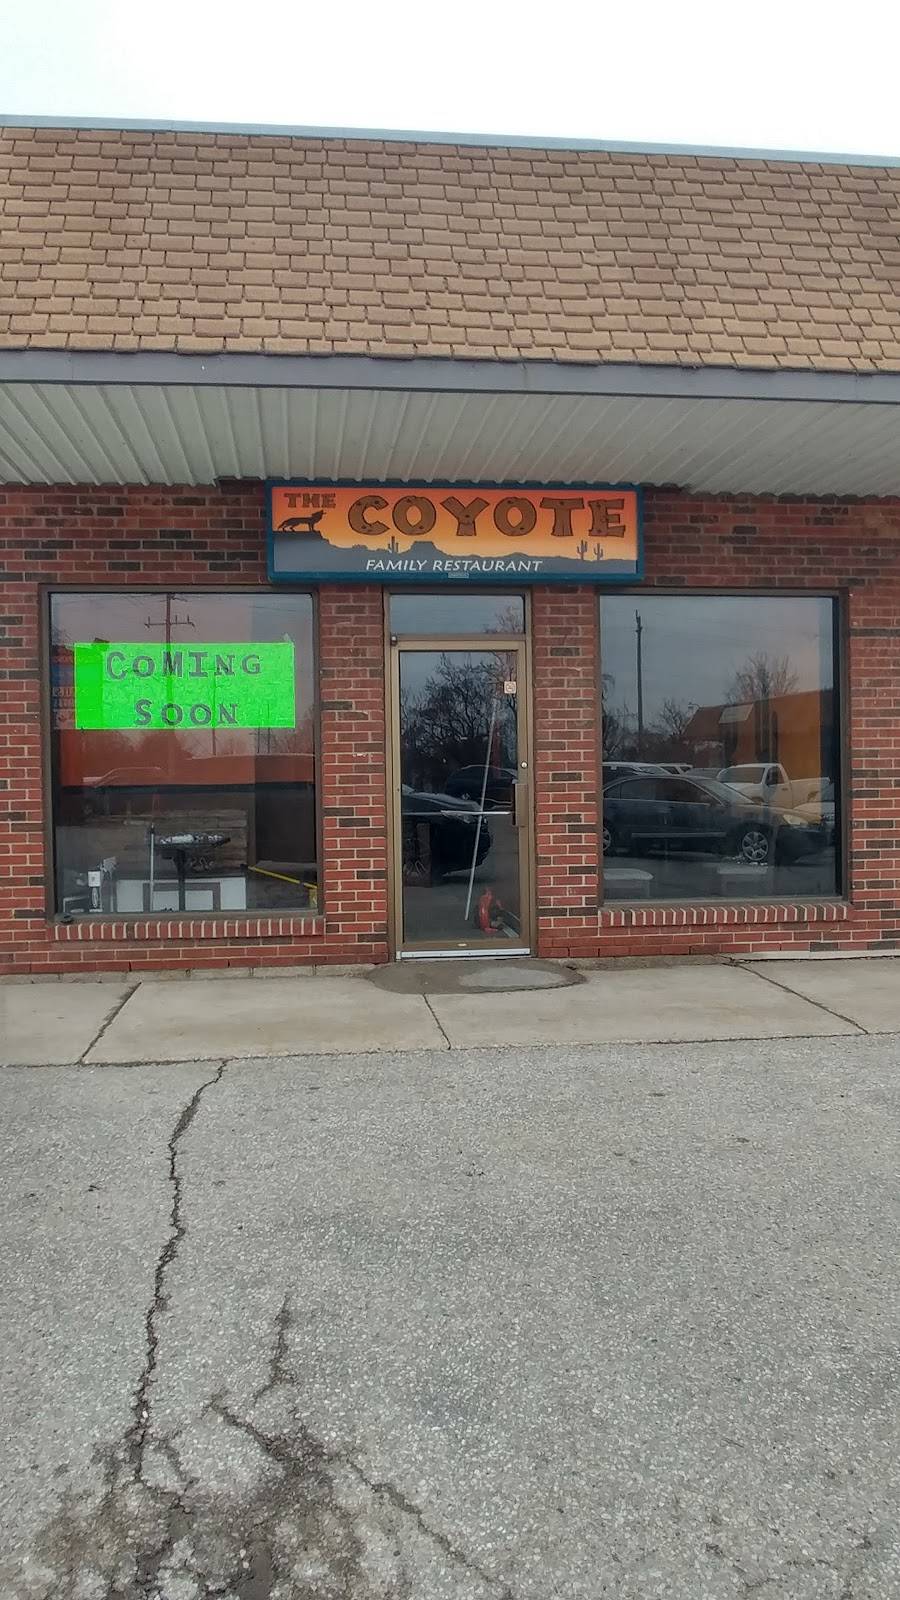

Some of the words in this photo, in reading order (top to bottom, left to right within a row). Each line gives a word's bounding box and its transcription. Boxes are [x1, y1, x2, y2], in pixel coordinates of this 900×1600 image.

[284, 493, 336, 509] THE
[347, 495, 626, 538] COYOTE
[365, 559, 428, 573] FAMILY
[432, 559, 543, 573] RESTAURANT
[134, 699, 238, 726] SOON
